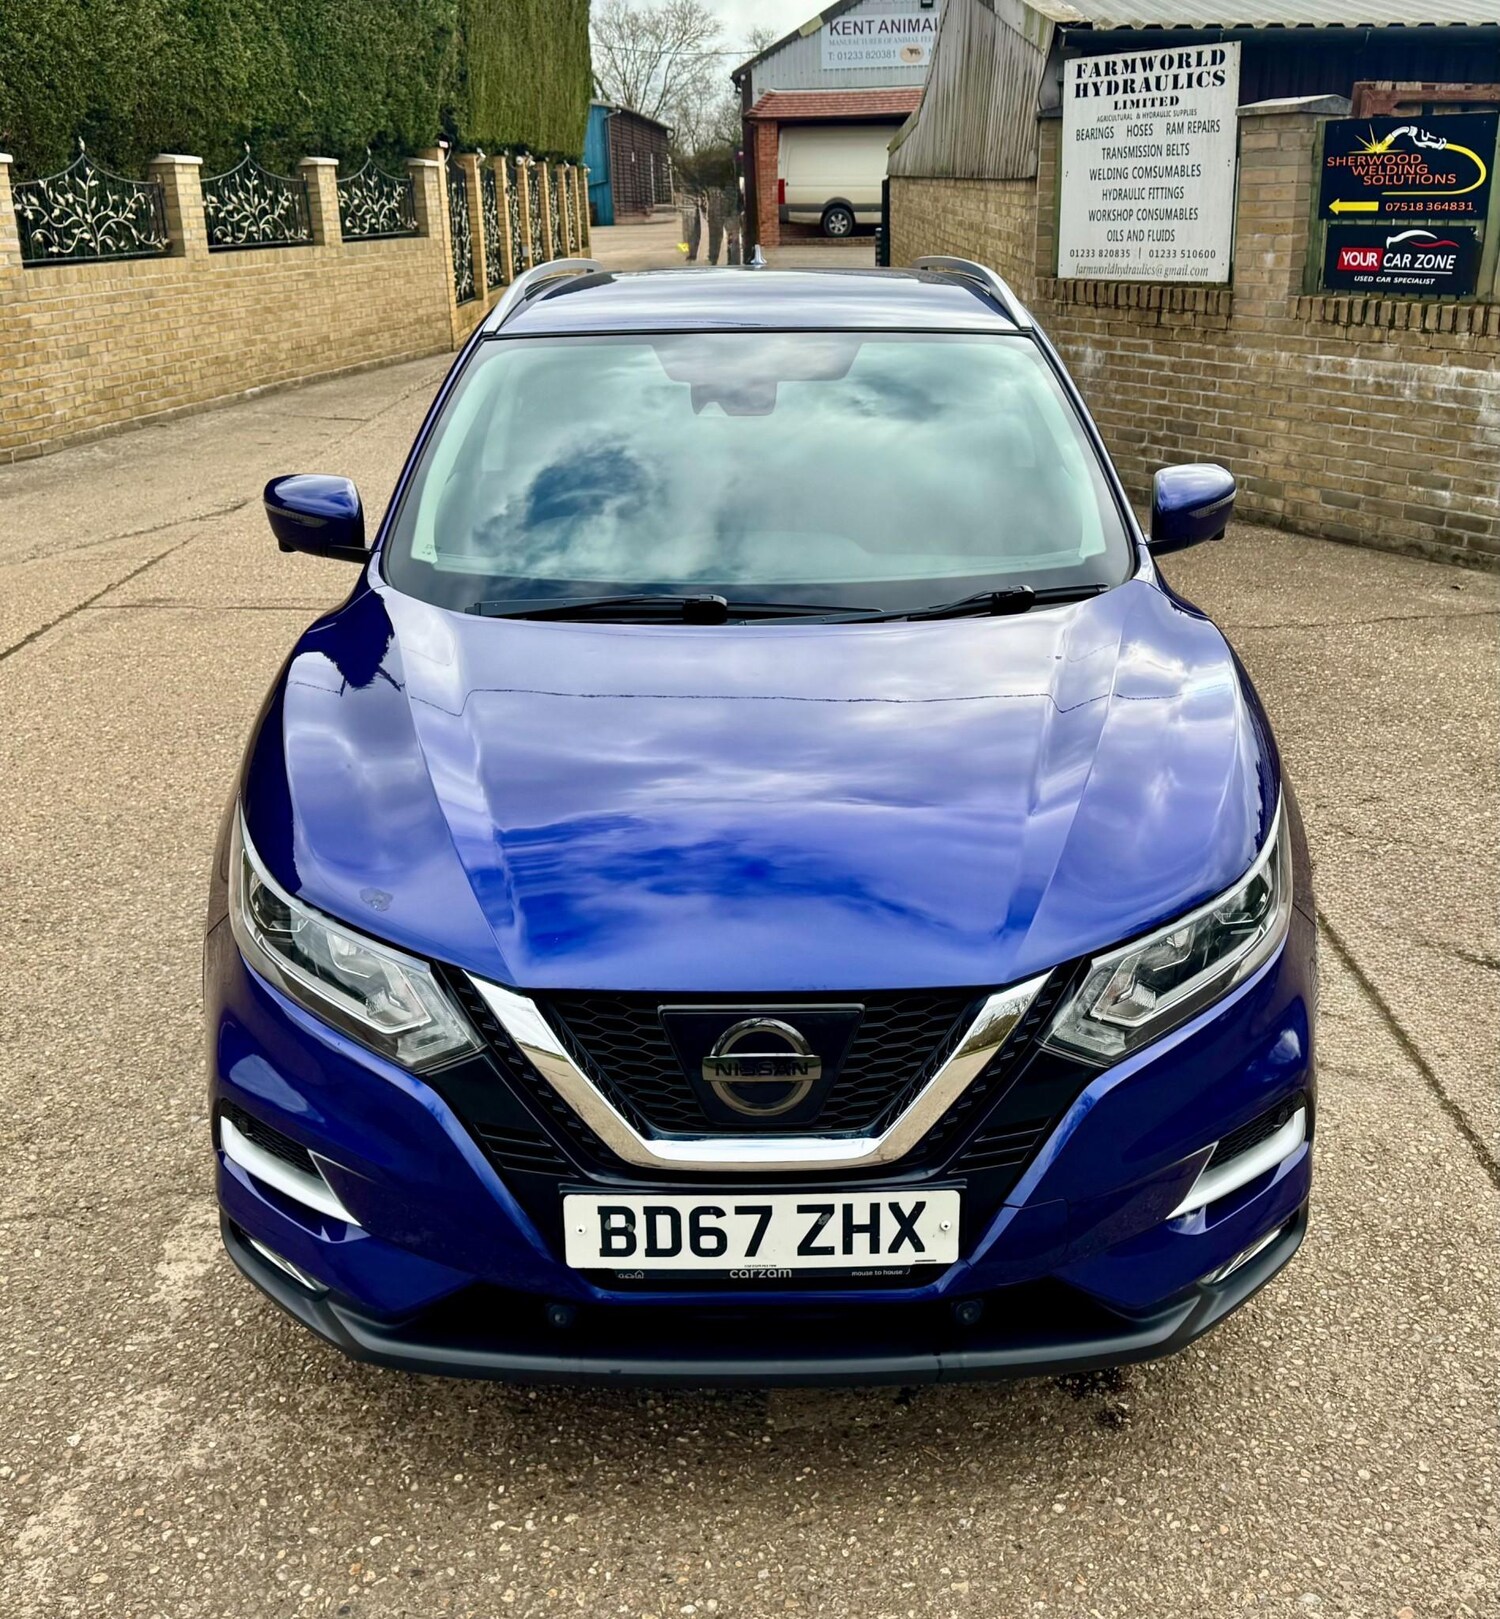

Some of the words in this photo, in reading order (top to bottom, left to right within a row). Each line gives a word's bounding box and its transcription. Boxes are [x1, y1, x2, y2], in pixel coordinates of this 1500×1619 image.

[830, 20, 875, 36] KENT
[828, 52, 835, 61] T:
[837, 51, 864, 60] 01233
[865, 50, 896, 59] 820381
[1076, 49, 1226, 79] FARMWORLD
[1075, 69, 1226, 98] HYDRAULICS
[1114, 95, 1180, 111] LIMITED
[1097, 113, 1133, 123] AGRICULTURAL
[1142, 110, 1171, 119] HYDRAULIC
[1173, 108, 1197, 117] SUPPLIES
[1076, 126, 1114, 141] BEARINGS
[1127, 123, 1153, 137] HOSES
[1166, 122, 1184, 135] RAM
[1187, 119, 1220, 133] REPAIRS
[1102, 144, 1162, 160] TRANSMISSION
[1166, 143, 1190, 157] BELTS
[1327, 153, 1422, 167] SHERWOOD
[1089, 167, 1129, 181] WELDING
[1352, 164, 1428, 176] WELDING
[1363, 173, 1457, 186] SOLUTIONS
[1102, 187, 1145, 201] HYDRAULIC
[1148, 186, 1184, 200] FITTINGS
[1385, 202, 1424, 212] 07518
[1426, 201, 1473, 211] 364831
[1088, 209, 1134, 221] WORKSHOP
[1136, 207, 1198, 221] CONSUMABLES
[1107, 229, 1124, 242] OILS
[1126, 229, 1145, 242] AND
[1147, 229, 1175, 242] FLUIDS
[1069, 249, 1095, 258] 01233
[1098, 249, 1130, 258] 820835
[1149, 249, 1177, 258] 01233
[1180, 249, 1216, 259] 510600
[1342, 251, 1378, 267] YOUR
[1383, 253, 1410, 268] CAR
[1414, 254, 1456, 270] ZONE
[1393, 277, 1435, 285] SPECIALIST
[715, 1061, 809, 1077] NISSAN
[597, 1205, 773, 1258] BD67
[796, 1201, 927, 1257] ZHX
[729, 1268, 792, 1279] carzam
